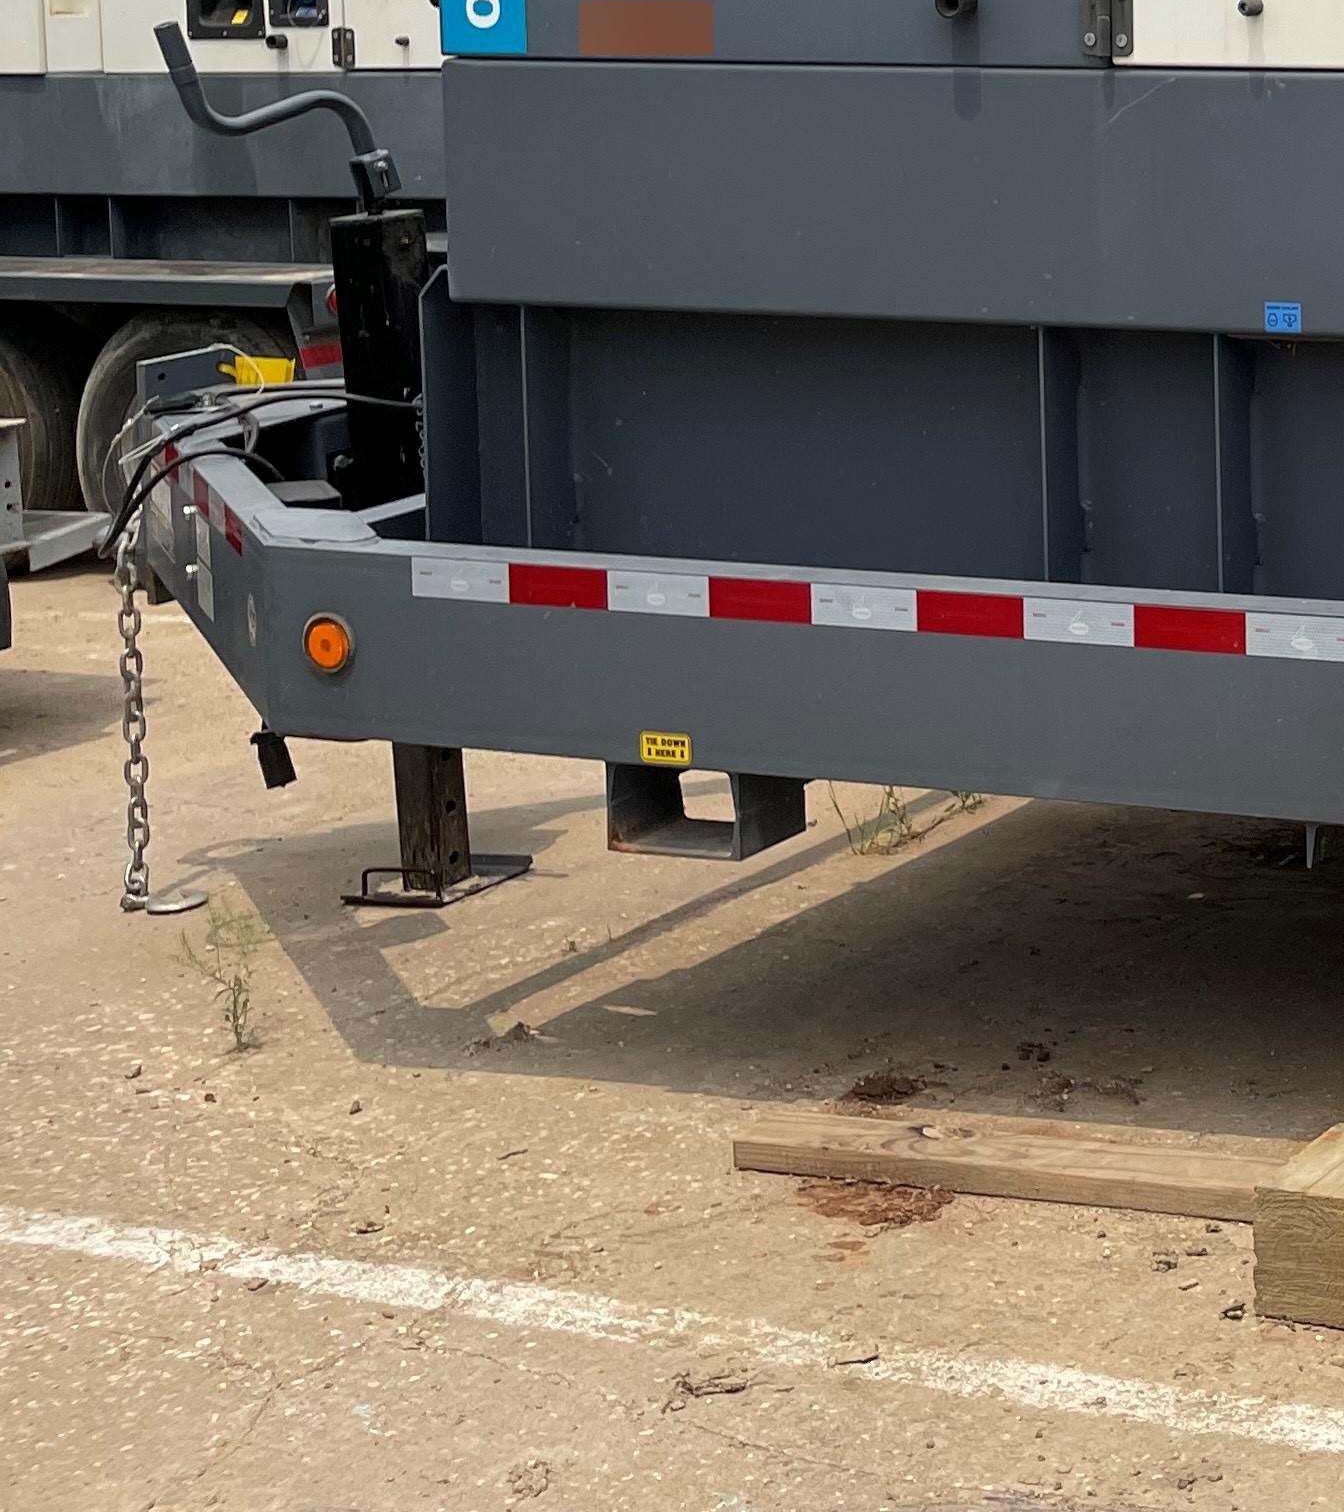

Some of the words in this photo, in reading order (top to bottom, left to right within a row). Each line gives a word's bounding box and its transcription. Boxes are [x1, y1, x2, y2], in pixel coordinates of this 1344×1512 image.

[645, 737, 658, 746] TIE
[661, 738, 686, 748] DOWN
[655, 749, 676, 758] HERE
